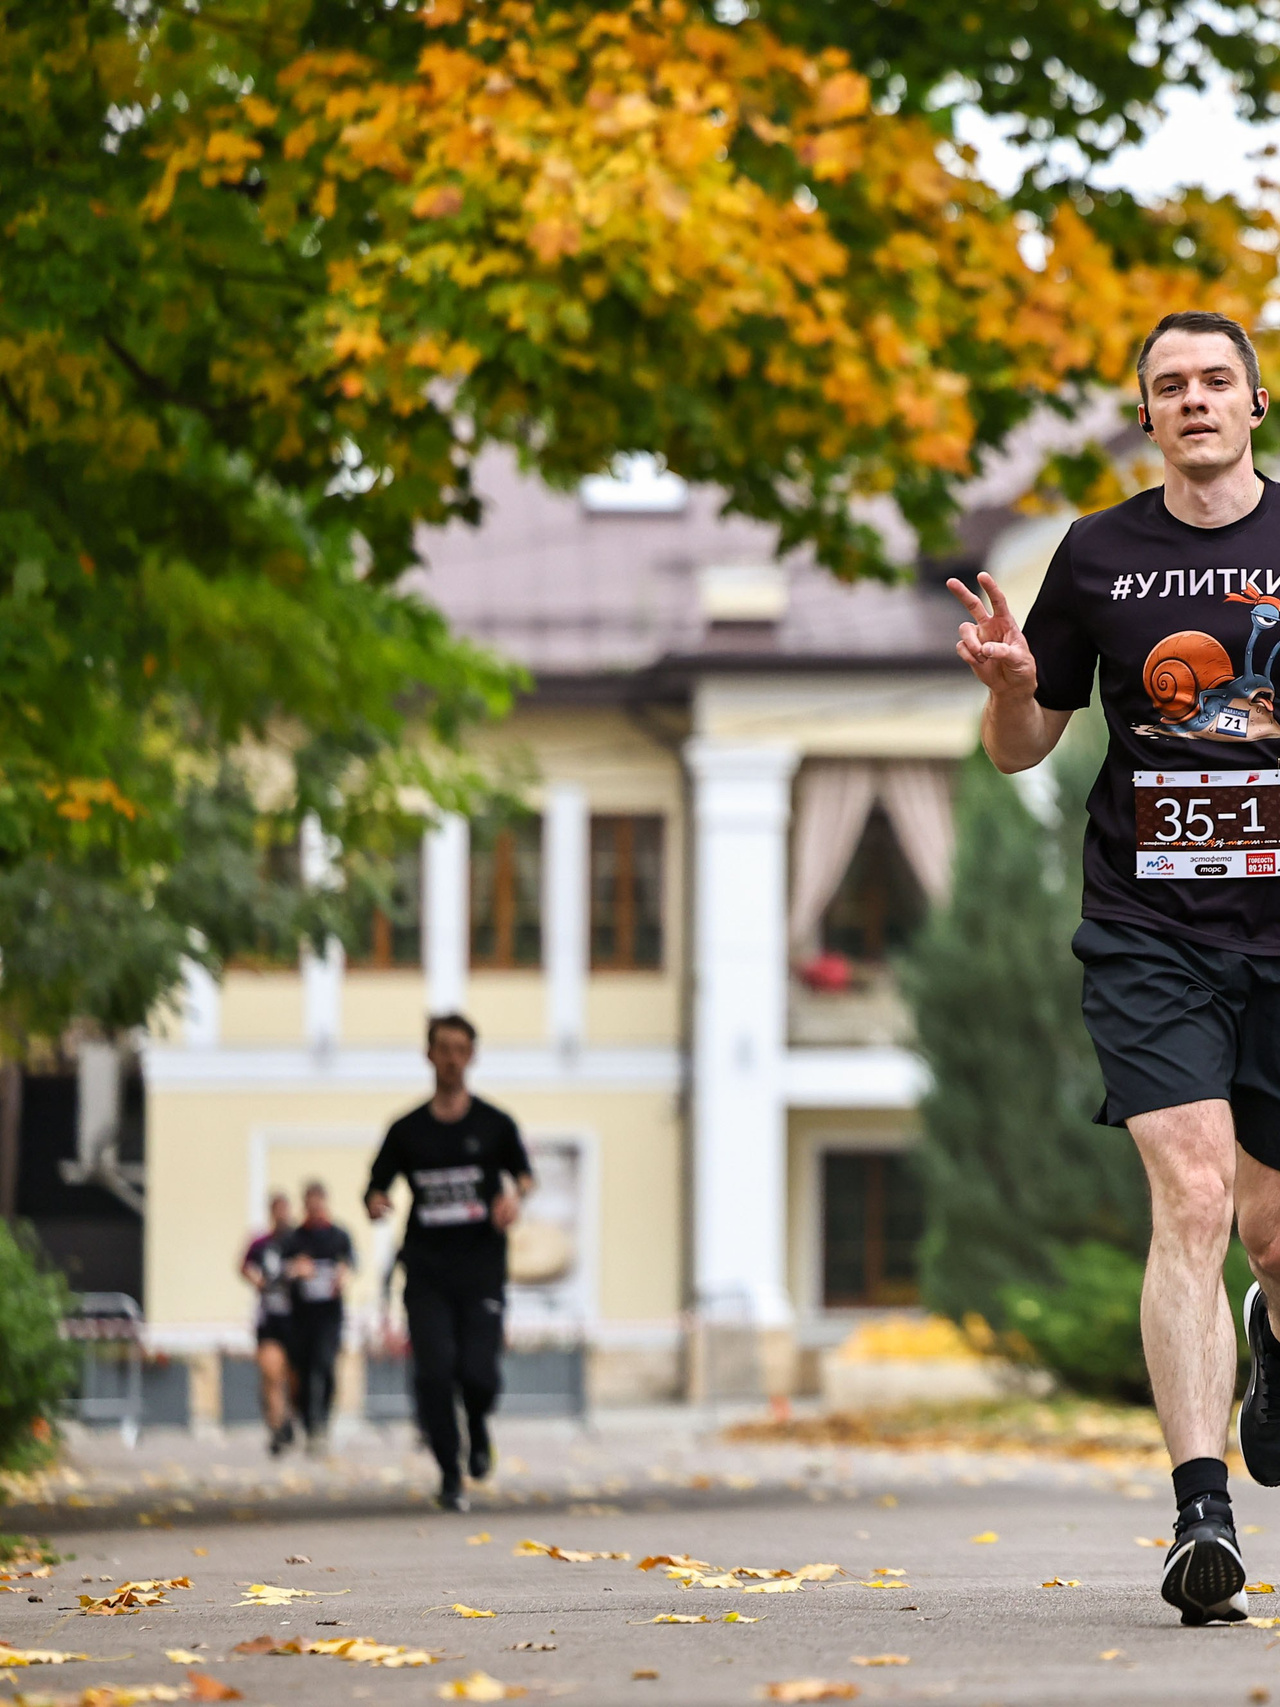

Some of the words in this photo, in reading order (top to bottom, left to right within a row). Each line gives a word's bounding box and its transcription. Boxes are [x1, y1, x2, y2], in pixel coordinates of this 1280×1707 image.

[1224, 716, 1241, 730] 71
[1154, 797, 1266, 842] 35-1
[1189, 855, 1233, 864] эстафета
[1248, 864, 1263, 873] 89.2
[1263, 863, 1274, 872] FM
